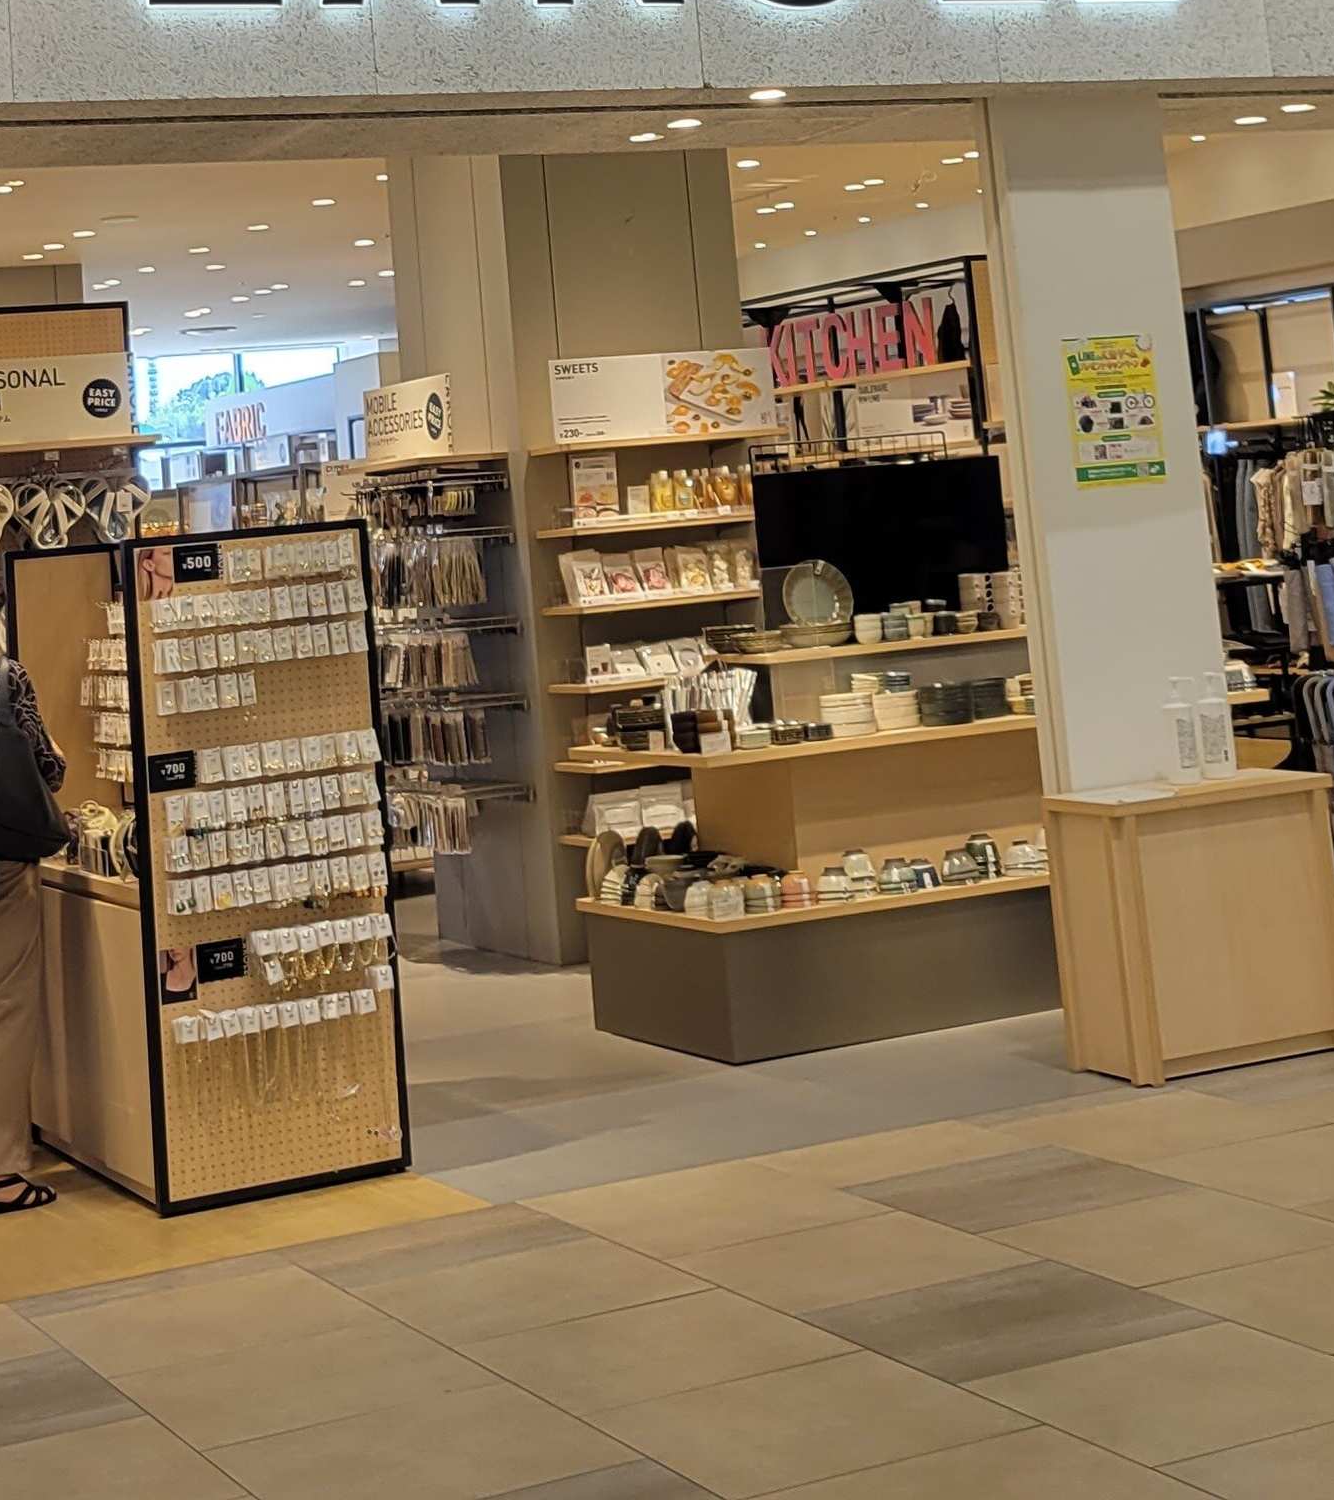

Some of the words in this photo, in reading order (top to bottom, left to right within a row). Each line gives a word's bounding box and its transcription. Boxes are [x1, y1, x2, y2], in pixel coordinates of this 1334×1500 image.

[759, 297, 937, 388] KITCHEN
[554, 362, 599, 376] SWEETS
[87, 396, 116, 407] PRICE
[88, 387, 116, 398] EASY
[366, 392, 397, 416] MOBILE
[215, 402, 267, 445] FABRIC
[368, 409, 424, 437] ACCESSORIES
[181, 555, 212, 570] ¥500
